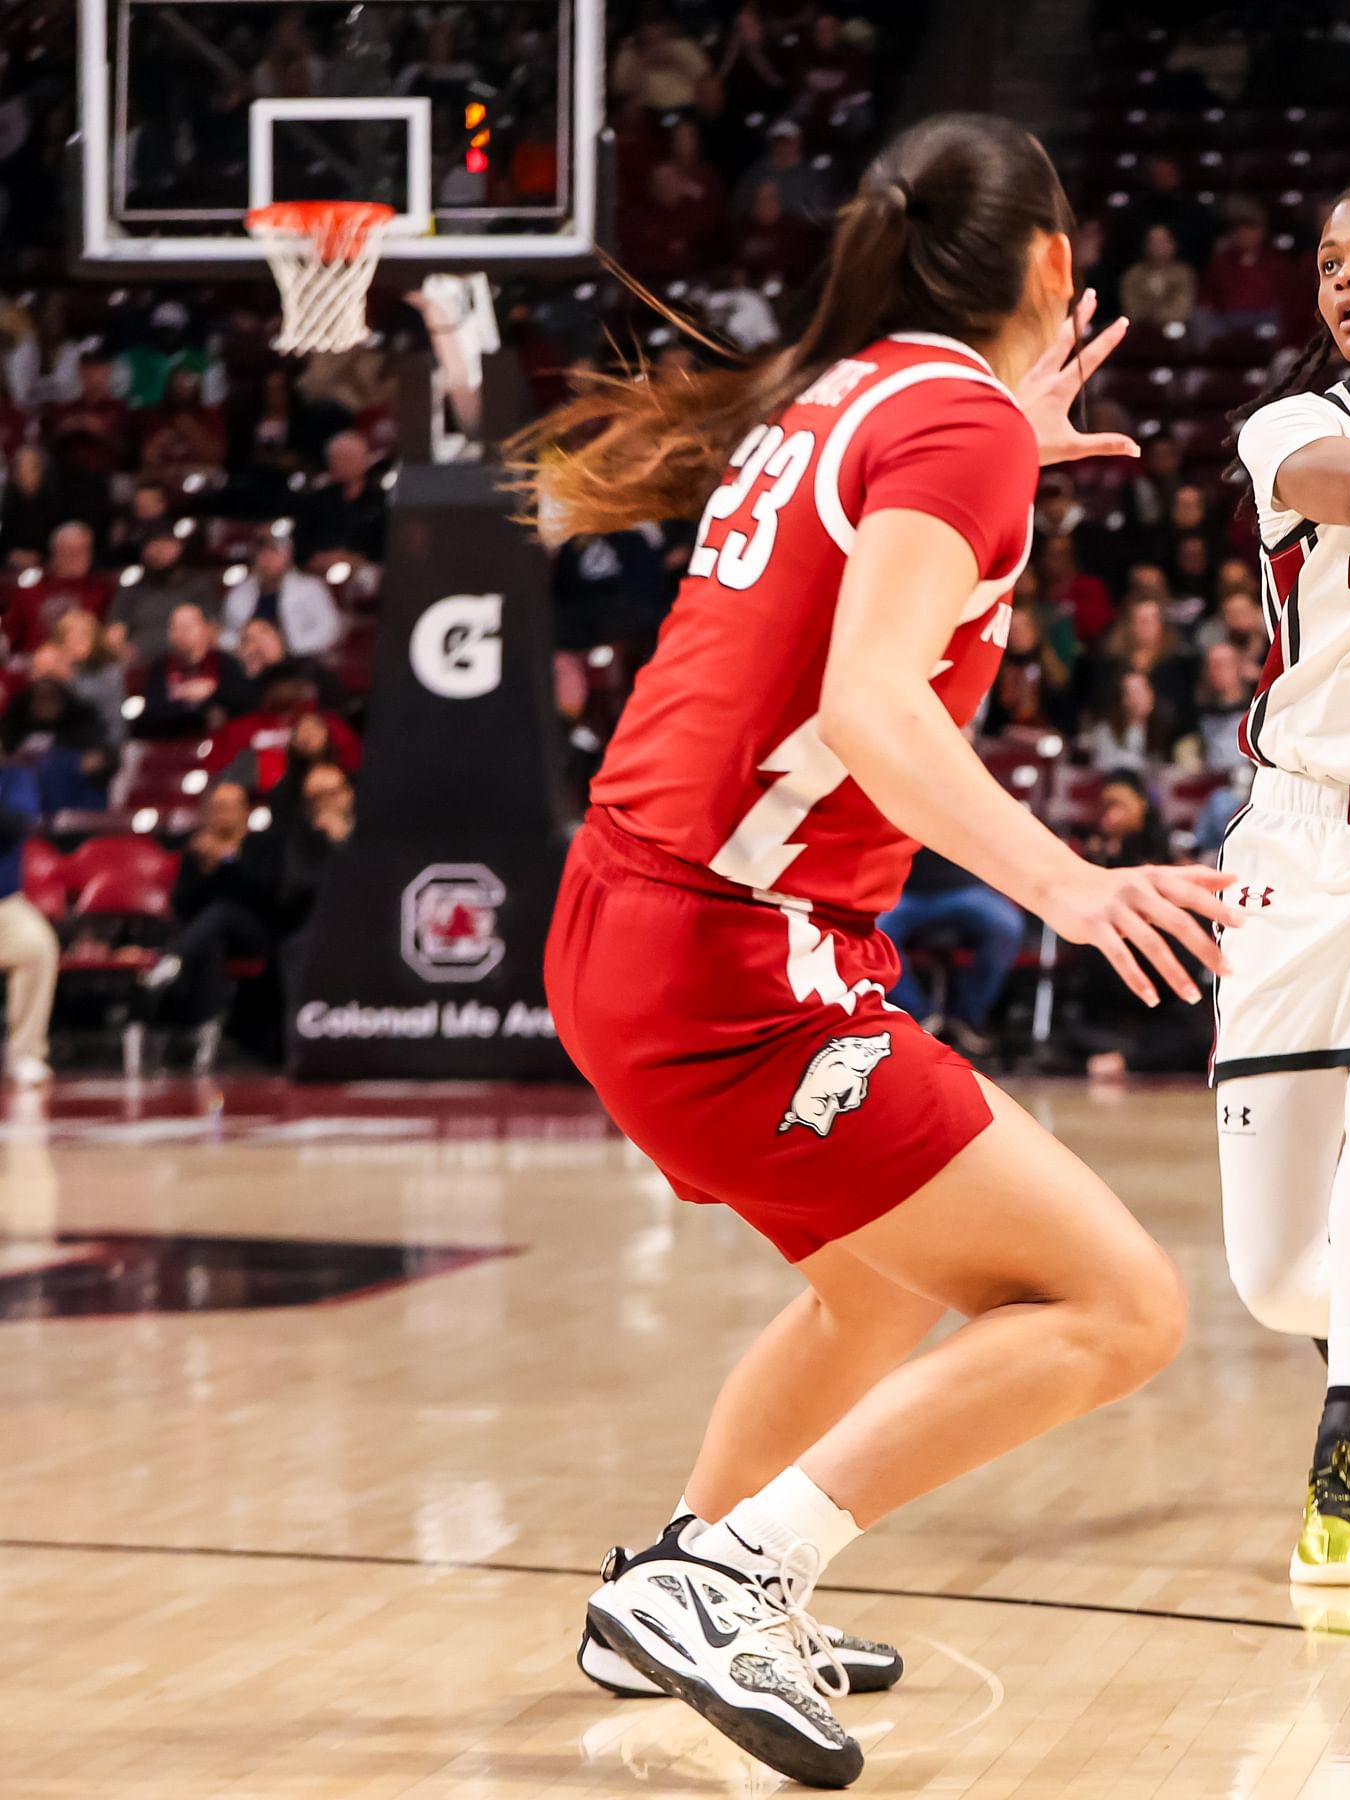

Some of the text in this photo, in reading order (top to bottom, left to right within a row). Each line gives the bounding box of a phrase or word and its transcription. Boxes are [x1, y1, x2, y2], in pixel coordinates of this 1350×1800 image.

[688, 423, 816, 590] 23
[408, 592, 503, 699] G
[297, 1001, 557, 1039] Colonial Life Are
